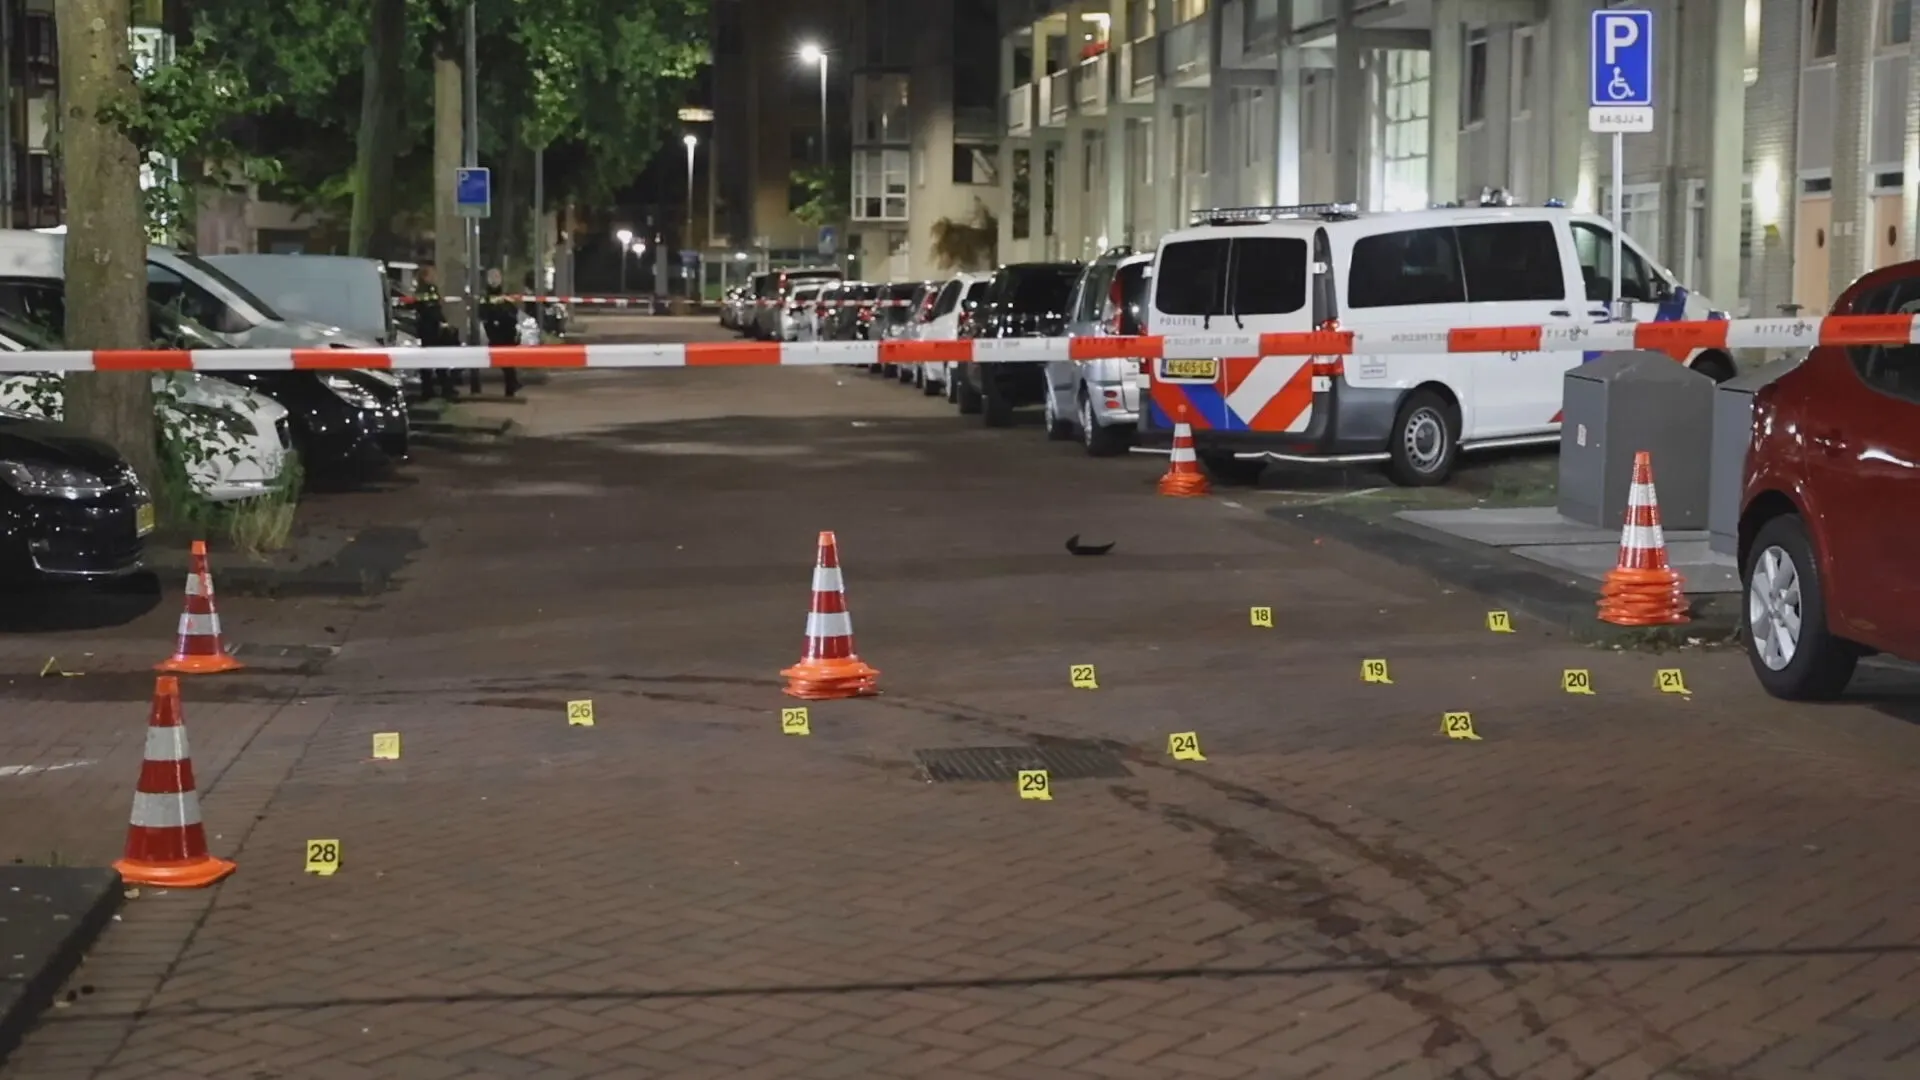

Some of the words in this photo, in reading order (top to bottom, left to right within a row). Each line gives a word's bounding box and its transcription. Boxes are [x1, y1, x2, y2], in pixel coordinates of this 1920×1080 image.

[1605, 16, 1639, 65] P
[1159, 316, 1197, 326] POLITIE
[1253, 610, 1268, 621] 18
[1491, 613, 1506, 625] 17
[1073, 667, 1092, 681] 22
[1367, 662, 1384, 676] 19
[1567, 672, 1587, 687] 20
[1662, 672, 1680, 686] 21
[570, 703, 590, 718] 26
[784, 711, 806, 726] 25
[1448, 715, 1470, 731] 23
[1173, 736, 1196, 752] 24
[1022, 774, 1046, 791] 29
[309, 843, 336, 863] 28
